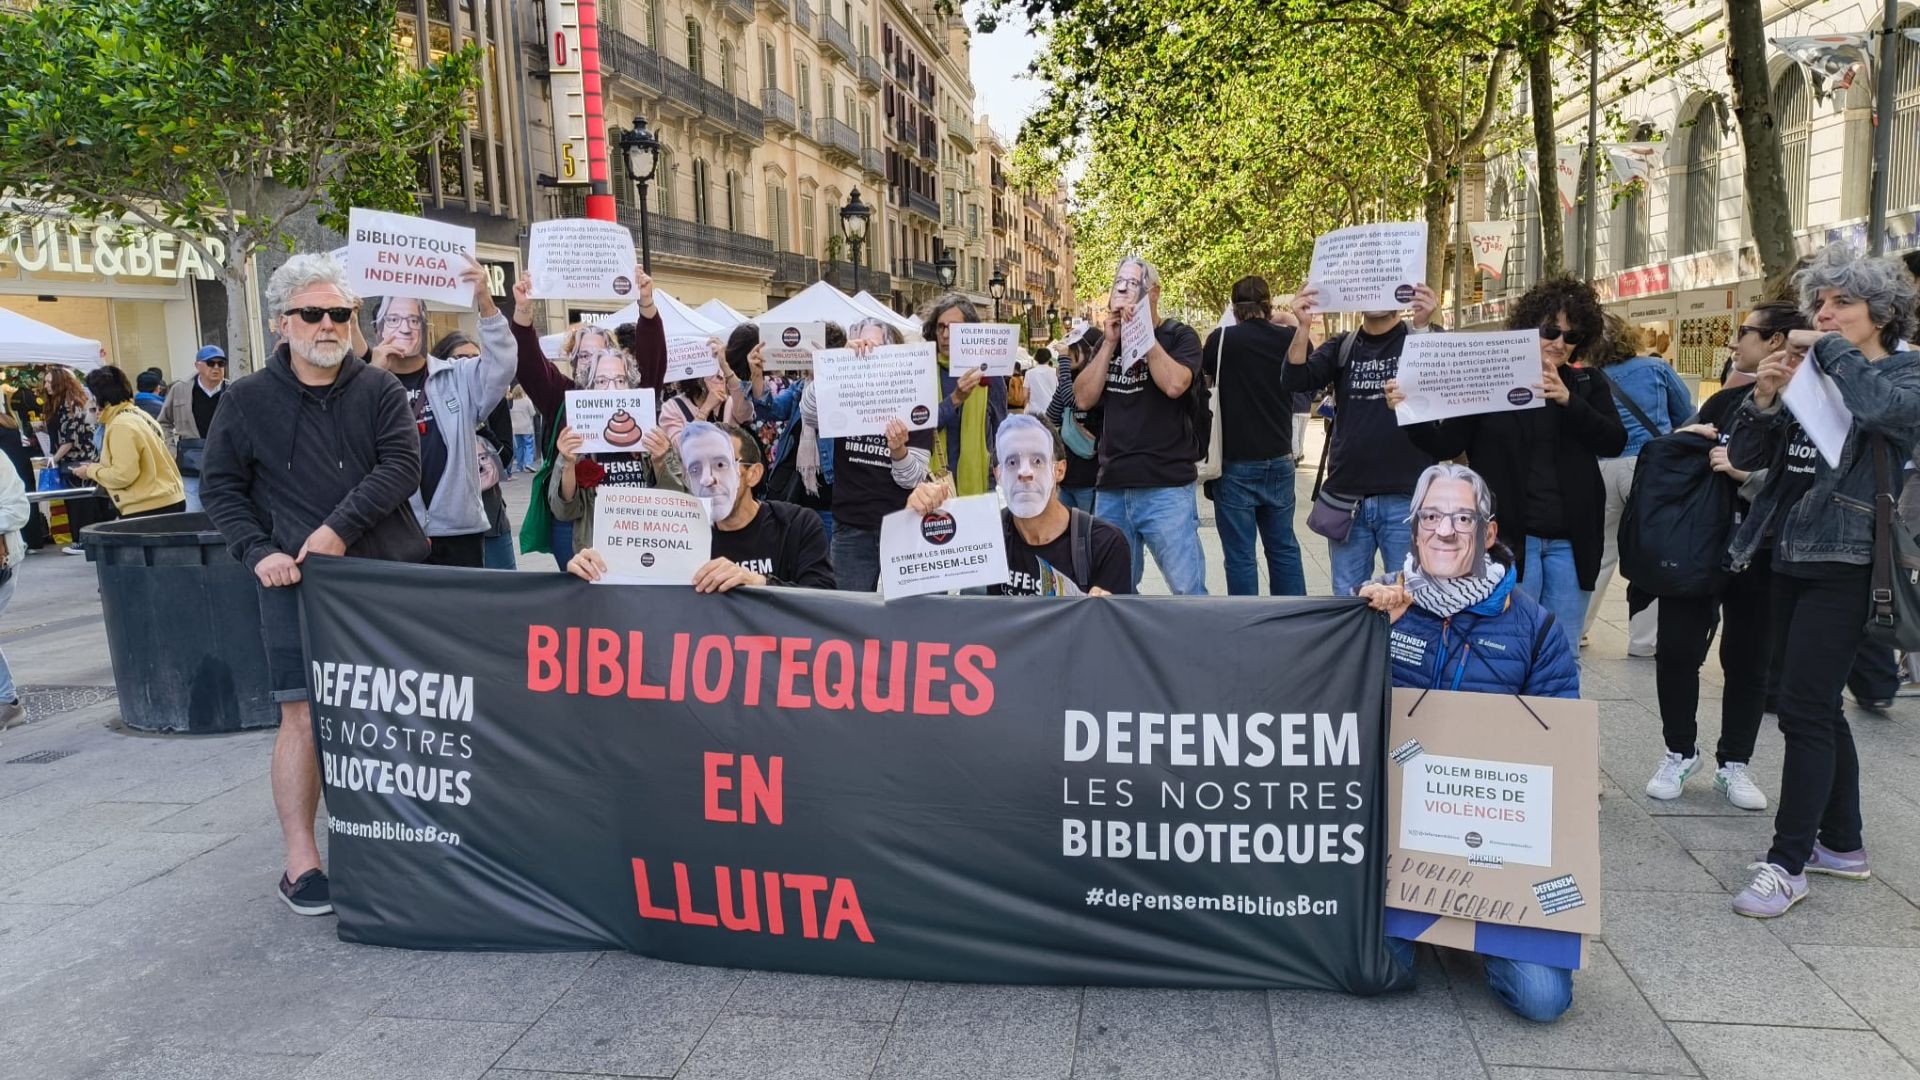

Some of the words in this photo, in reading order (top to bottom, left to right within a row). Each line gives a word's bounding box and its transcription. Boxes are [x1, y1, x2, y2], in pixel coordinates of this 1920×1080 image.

[554, 32, 567, 65] 0
[562, 143, 575, 177] 5
[356, 229, 467, 257] BIBLIOTEQUES
[377, 251, 400, 265] EN
[405, 253, 448, 271] VAGA
[365, 268, 457, 290] INDEFINIDA
[962, 337, 996, 345] LLIURES
[669, 351, 710, 363] ALTRACTAT
[576, 399, 613, 408] CONVENI
[616, 398, 641, 408] 25-28
[580, 432, 599, 440] ERDA
[867, 436, 886, 445] NOS
[845, 441, 891, 457] BIBLIOTEQ
[610, 473, 641, 481] NOSTR
[606, 494, 617, 502] NO
[619, 495, 651, 504] PODEM
[616, 508, 644, 516] SERVEI
[661, 510, 700, 519] QUALITAT
[613, 520, 639, 531] AMB
[643, 521, 689, 534] MANCA
[608, 536, 623, 546] DE
[627, 537, 693, 550] PERSONAL
[891, 552, 923, 563] ESTIMEM
[924, 550, 939, 558] LES
[940, 542, 994, 555] BIBLIOTEQUES
[899, 554, 988, 575] DEFENSEM-LES!
[1390, 631, 1427, 648] DEFENSEM
[527, 623, 997, 717] BIBLIOTEQUES
[312, 660, 474, 722] DEFENSEM
[320, 716, 332, 742] ES
[341, 721, 473, 759] NOSTRES
[1063, 709, 1361, 768] DEFENSEM
[1424, 763, 1470, 778] VOLEM
[1474, 769, 1528, 784] BIBLIOS
[703, 751, 784, 825] EN
[1063, 777, 1134, 807] LES
[1161, 781, 1363, 810] NOSTRES
[1426, 781, 1496, 800] LLIURES
[1503, 789, 1525, 803] DE
[1424, 799, 1526, 823] VIOLÈNCIES
[1062, 818, 1365, 865] BIBLIOTEQUES
[1401, 857, 1474, 888] DOBLAR
[1401, 882, 1419, 903] VA
[1424, 886, 1437, 906] A
[1534, 876, 1575, 895] DEFENSEM
[631, 857, 875, 944] LLUITA
[1085, 887, 1338, 917] #defensemBibliosBcn
